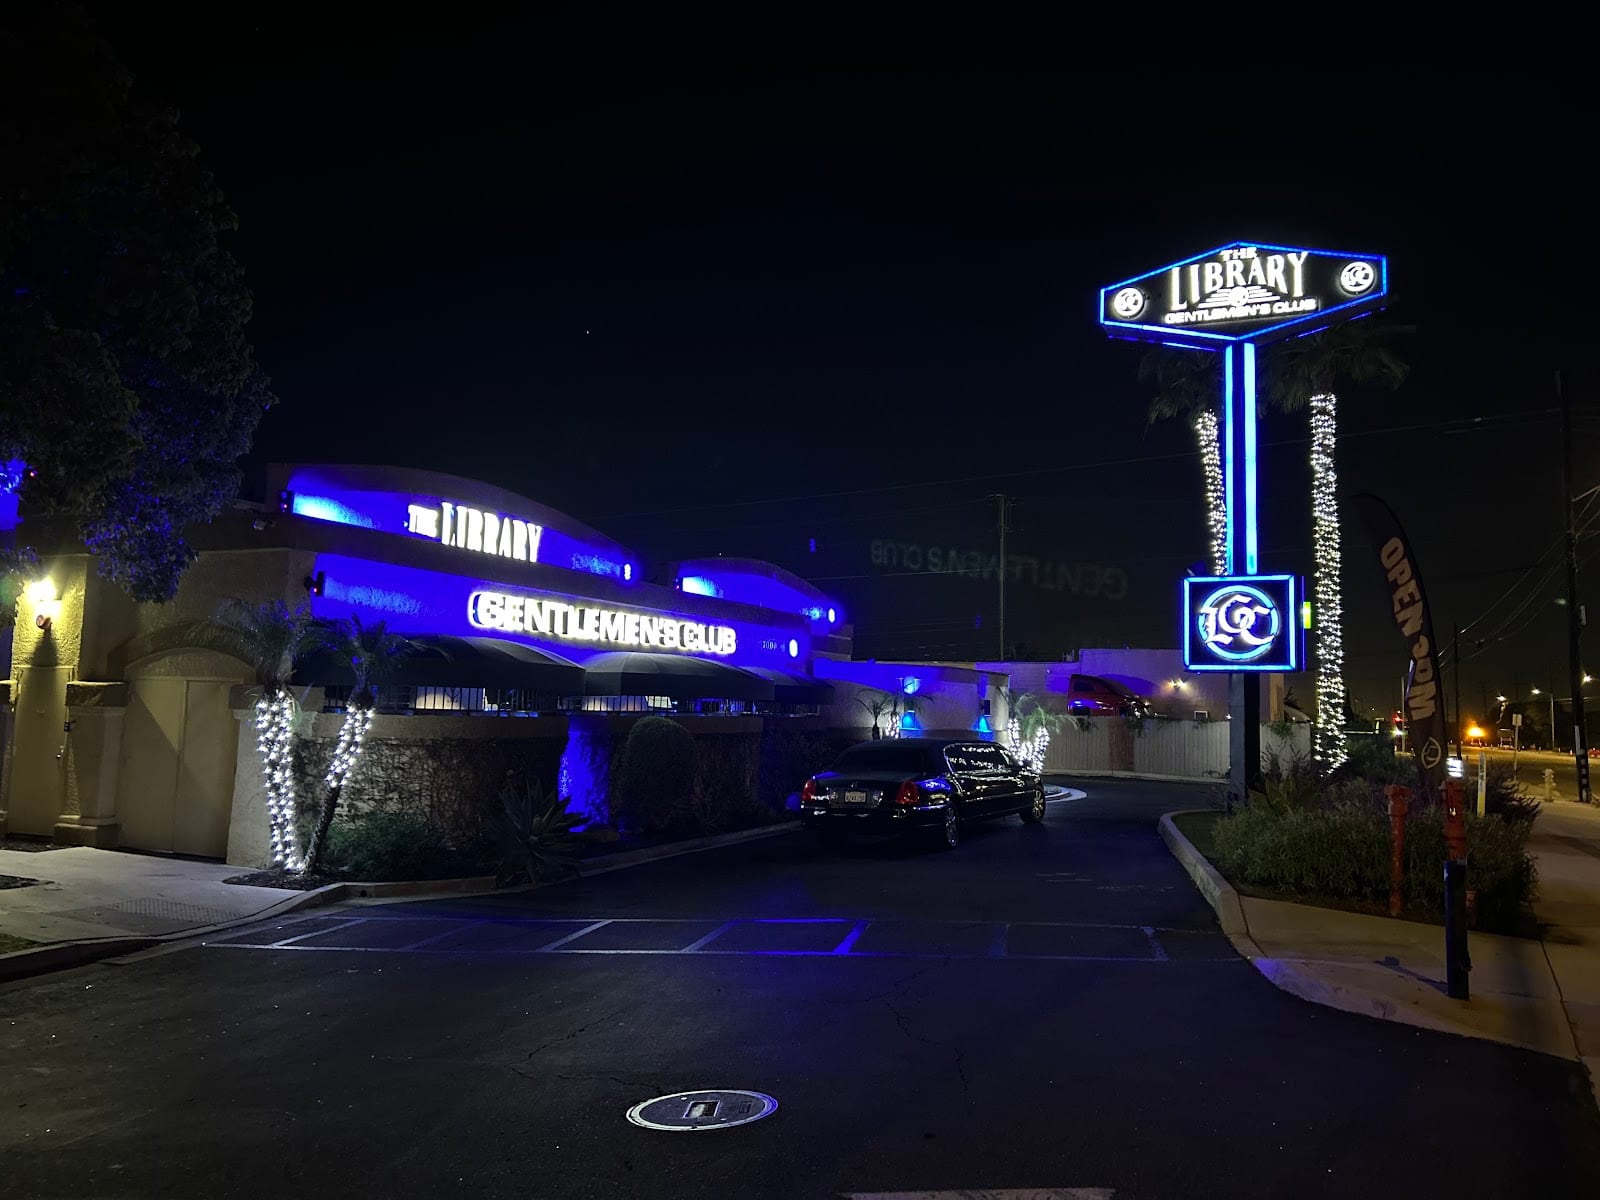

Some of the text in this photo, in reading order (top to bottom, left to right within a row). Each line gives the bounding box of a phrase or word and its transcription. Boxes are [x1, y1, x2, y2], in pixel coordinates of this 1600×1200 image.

[1170, 251, 1309, 311] LIBRARY
[1219, 246, 1258, 261] THE
[1165, 298, 1317, 324] GENTLEMEN'S CLUB
[408, 501, 543, 563] THE LIBRARY
[1380, 535, 1423, 638] OPEN
[468, 592, 737, 655] GENTLEMEN'S CLUB
